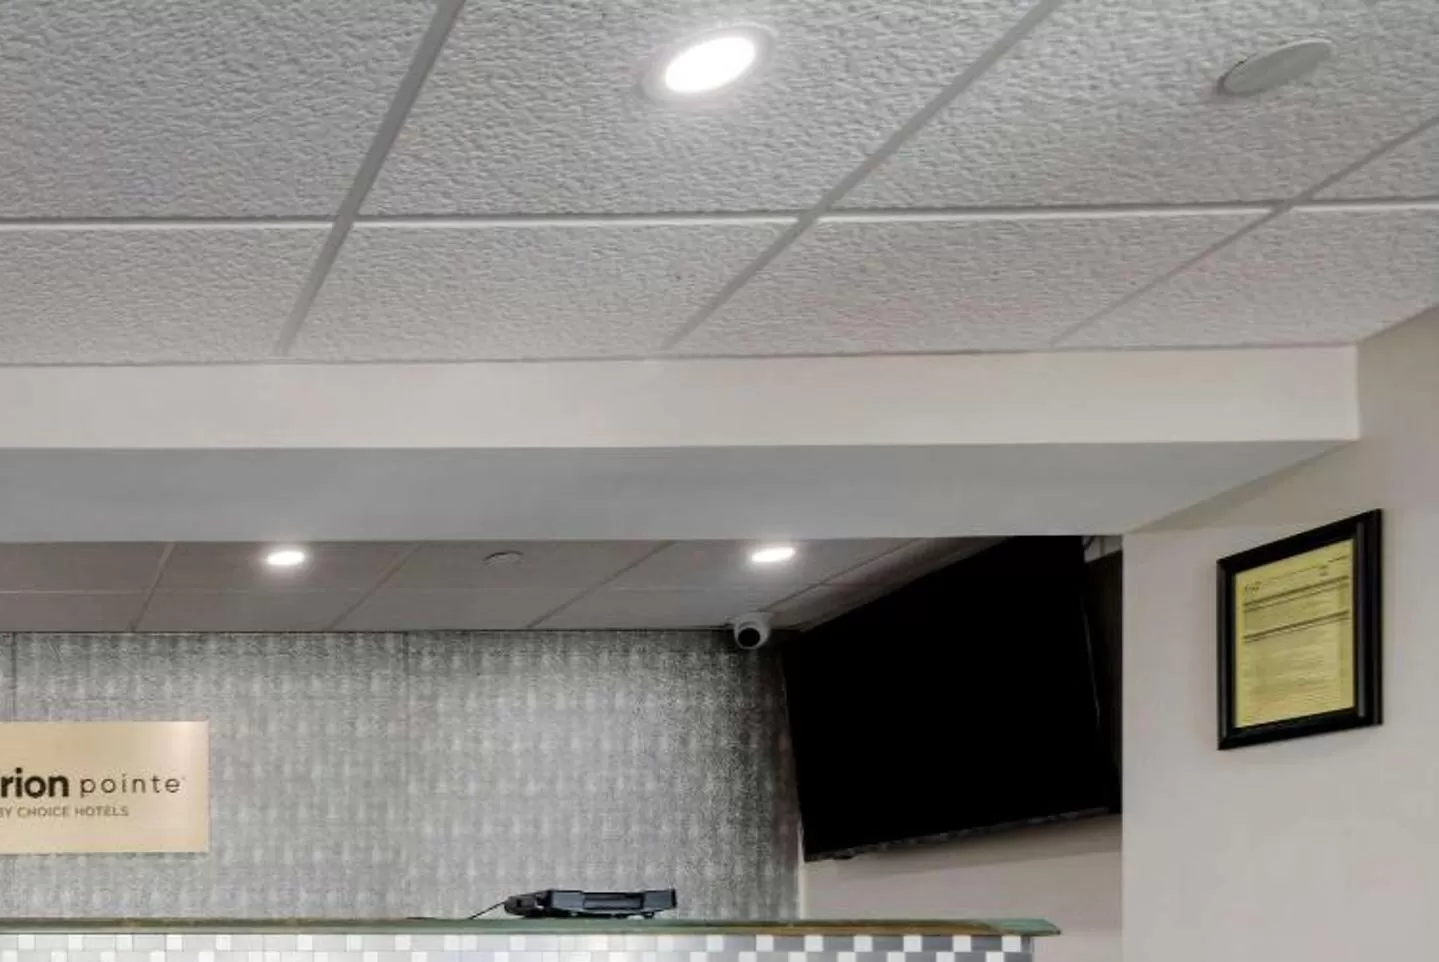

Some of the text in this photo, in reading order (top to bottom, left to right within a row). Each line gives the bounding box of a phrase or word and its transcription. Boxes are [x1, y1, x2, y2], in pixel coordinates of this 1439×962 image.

[80, 773, 181, 798] pointe
[17, 806, 70, 818] CHOICE
[75, 805, 129, 817] HOTELS
